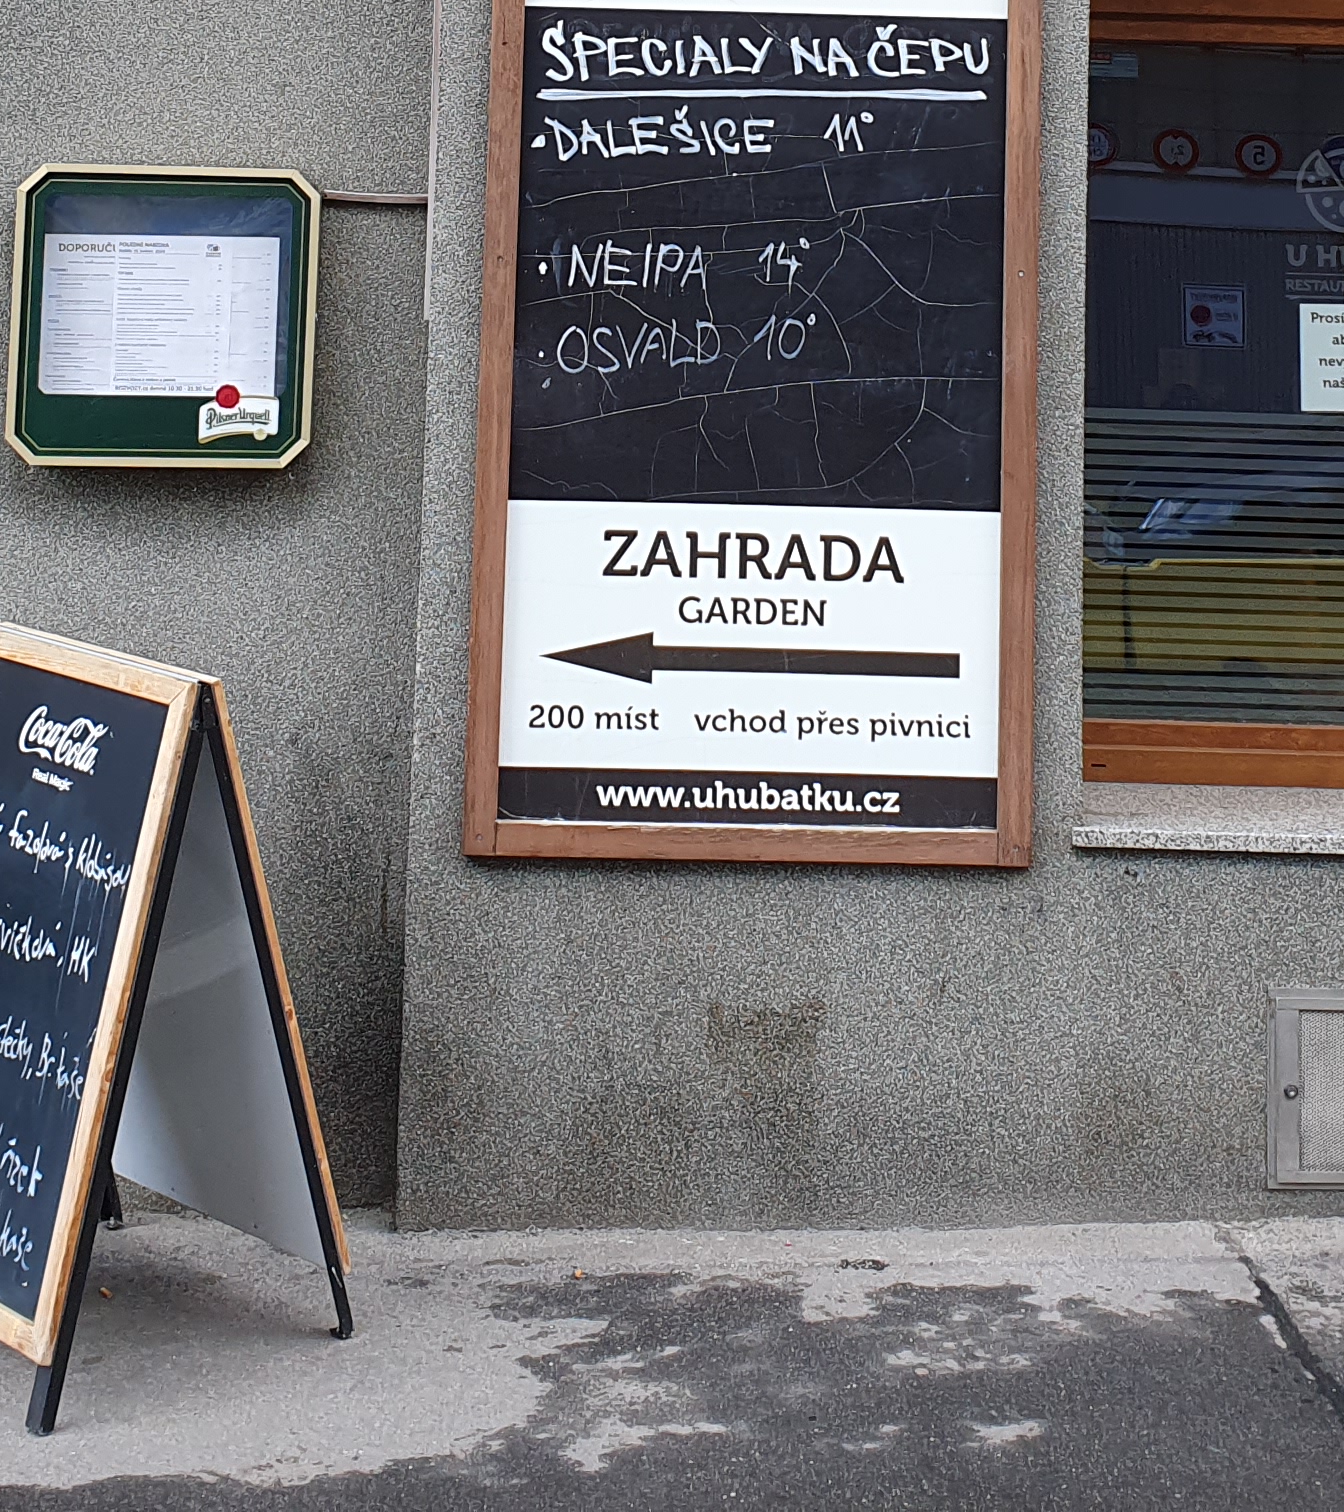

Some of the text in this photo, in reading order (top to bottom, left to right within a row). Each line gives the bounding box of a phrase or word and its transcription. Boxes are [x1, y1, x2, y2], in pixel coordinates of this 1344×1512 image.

[541, 20, 991, 82] SPECIALY NA ČEPU
[544, 105, 874, 162] DALEŠICE 11°
[757, 237, 811, 294] 14°
[1285, 244, 1309, 267] U
[754, 313, 817, 361] 10°
[205, 407, 270, 430] Pilsner Urquell
[602, 529, 905, 584] ZAHRADA
[678, 596, 828, 627] GARDEN
[19, 705, 110, 776] Coca-Cola
[528, 705, 971, 743] 200 míst vchod přes pivnici
[596, 781, 901, 815] www.uhubatku.cz
